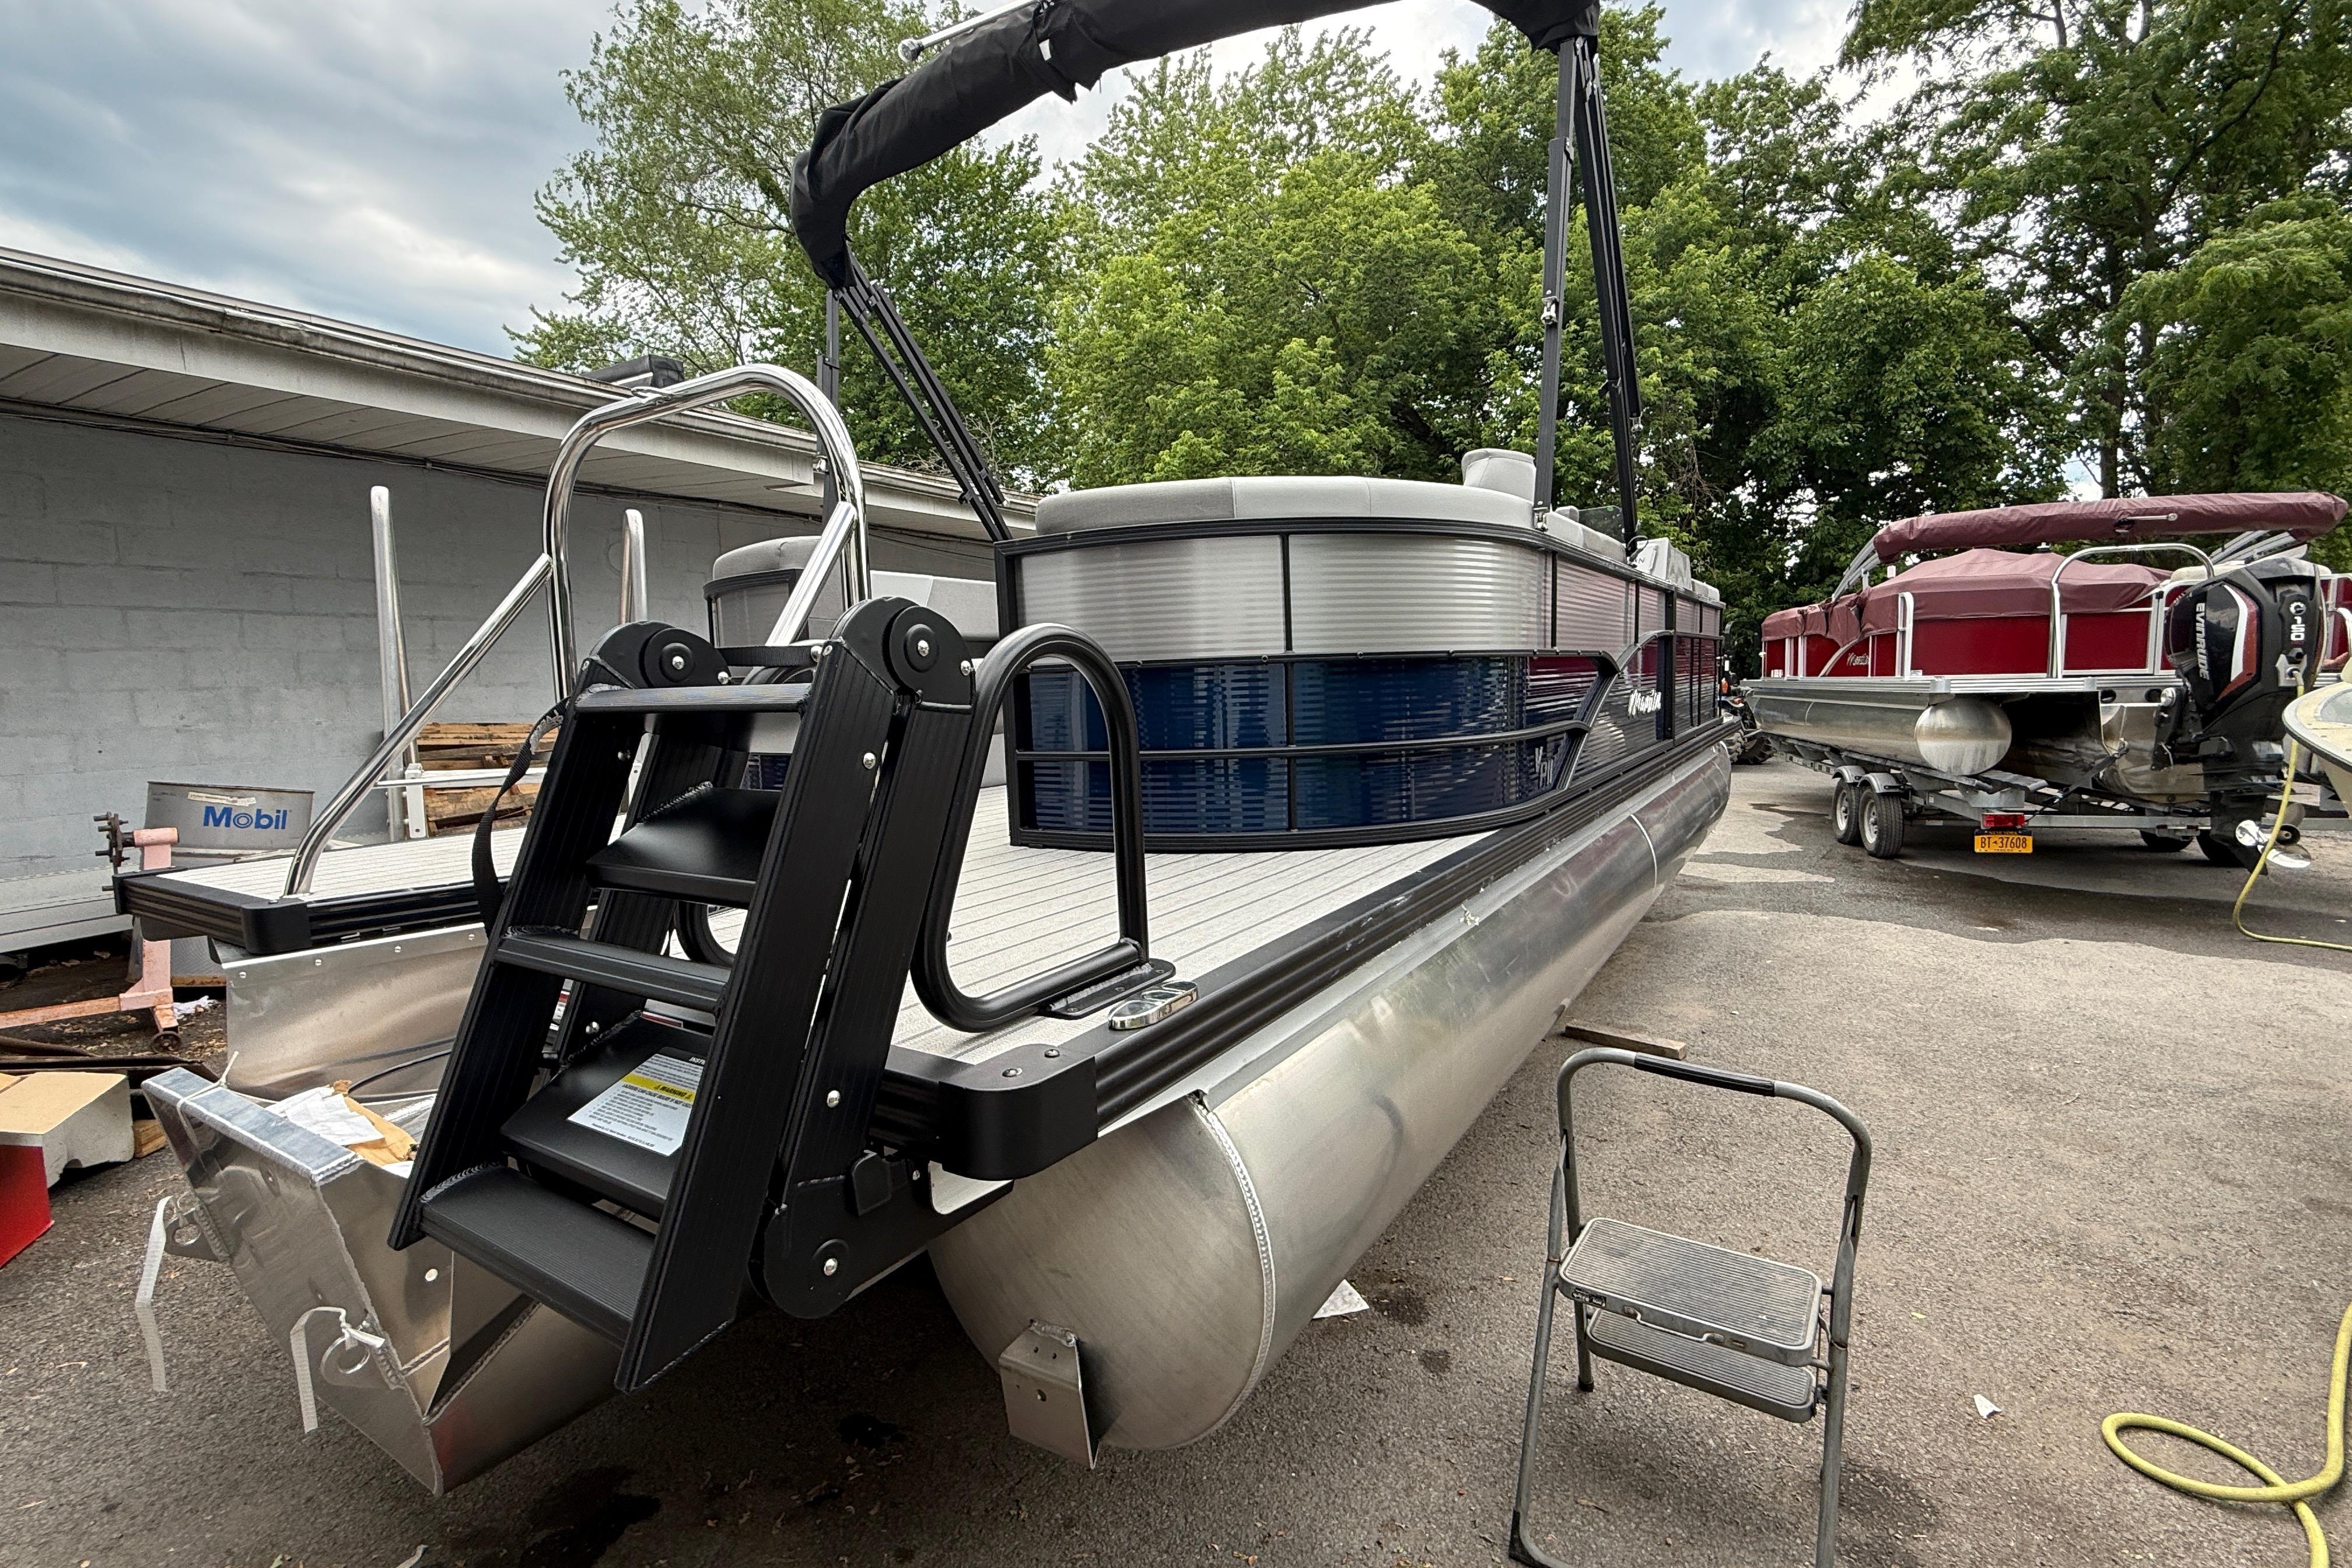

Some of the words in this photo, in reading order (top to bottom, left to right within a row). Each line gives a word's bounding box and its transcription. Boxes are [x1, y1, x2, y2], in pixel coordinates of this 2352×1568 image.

[2290, 616, 2305, 640] 150
[2196, 603, 2210, 680] EVINRUDE
[203, 806, 288, 830] Mobil
[1980, 836, 1992, 848] BT
[1998, 836, 2027, 849] 37608
[659, 1086, 688, 1097] WARNING
